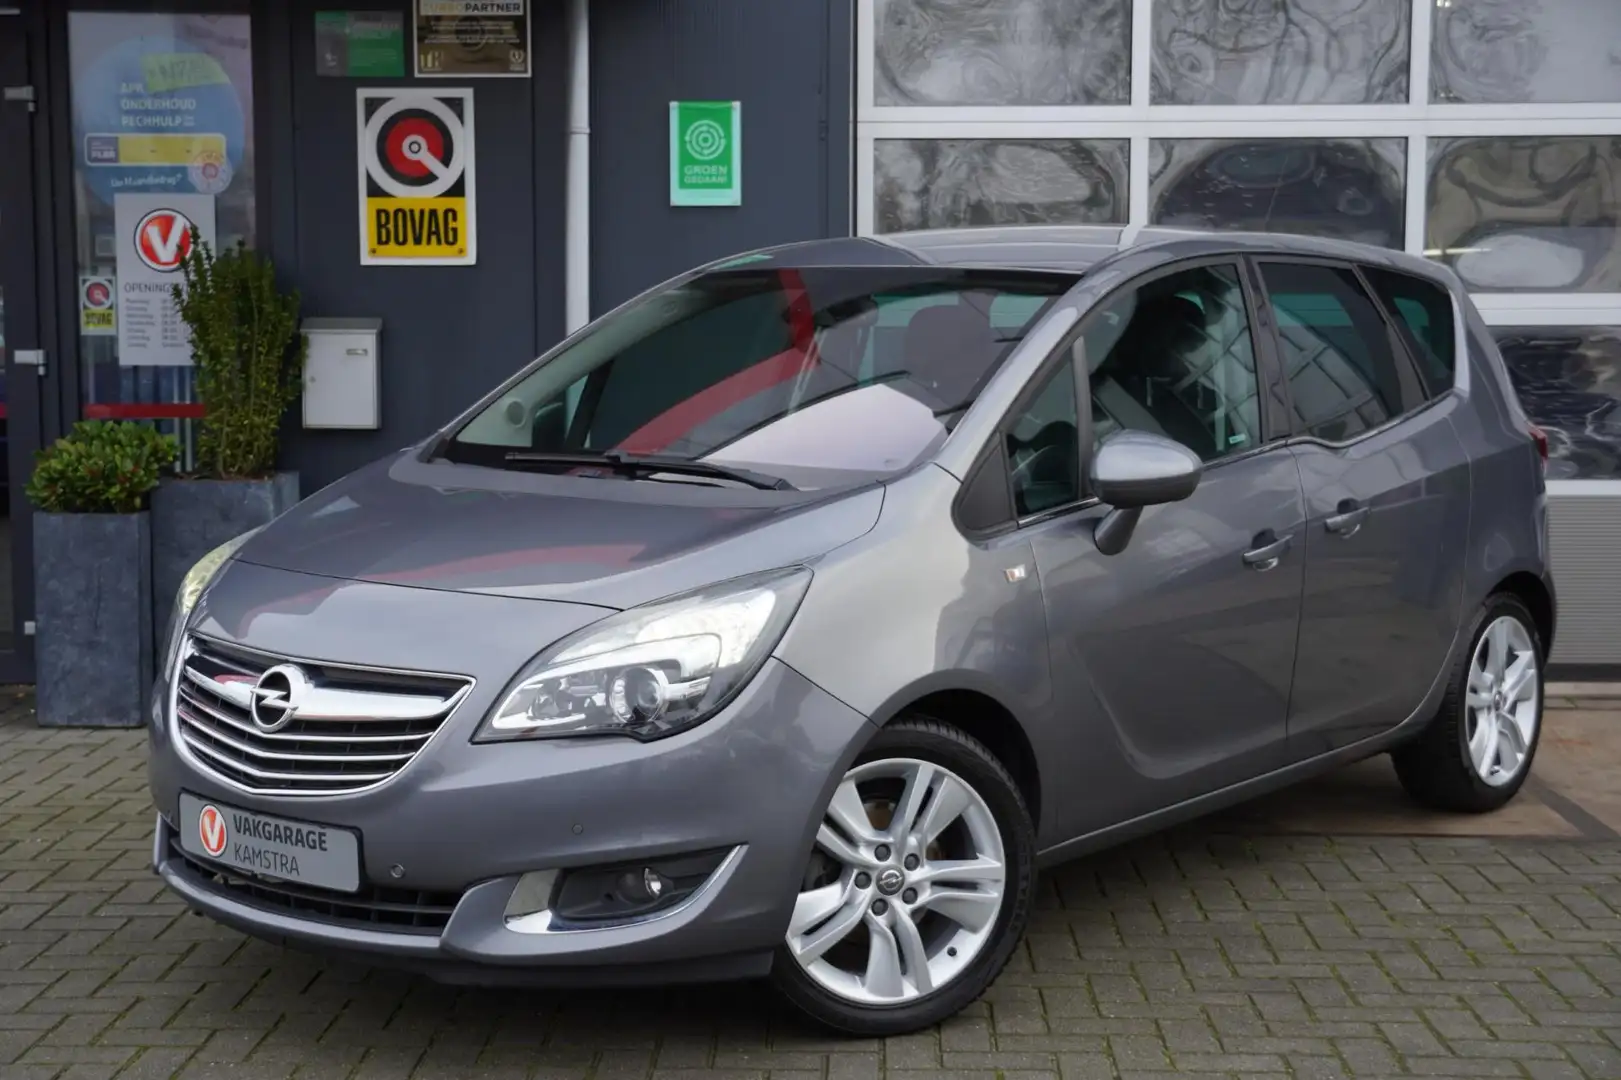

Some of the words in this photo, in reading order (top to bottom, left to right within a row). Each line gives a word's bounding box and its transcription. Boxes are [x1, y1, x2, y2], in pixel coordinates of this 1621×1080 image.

[121, 99, 197, 110] ONDERHOUD
[121, 116, 182, 127] PECHHULP
[684, 165, 728, 175] GROEN
[376, 208, 458, 246] BOVAG
[233, 814, 328, 851] VAKGARAGE
[234, 843, 300, 876] KAMSTRA
